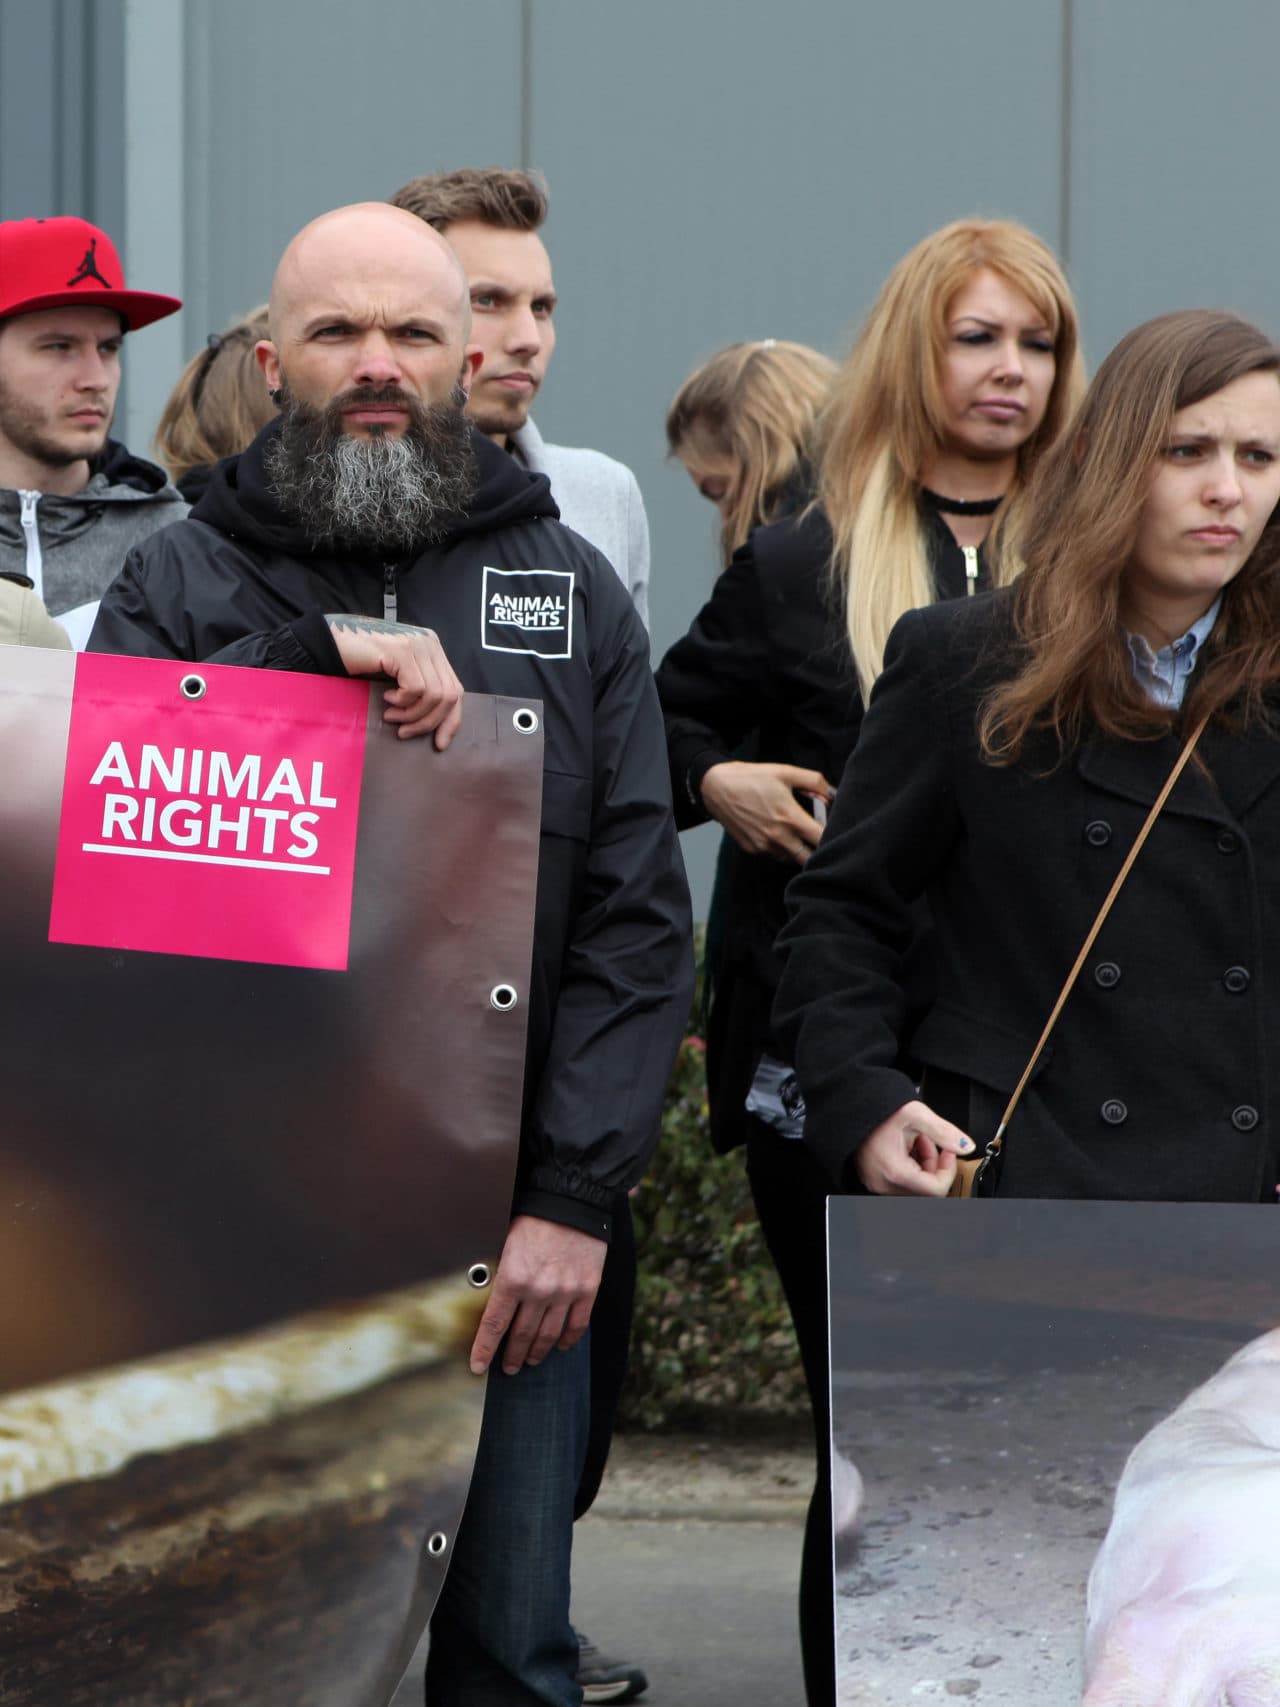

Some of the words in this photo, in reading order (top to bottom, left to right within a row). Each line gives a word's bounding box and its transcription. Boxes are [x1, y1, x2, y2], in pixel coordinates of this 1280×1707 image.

[489, 593, 566, 612] ANIMAL
[494, 606, 561, 626] RIGHTS
[89, 741, 337, 808] ANIMAL
[101, 793, 321, 858] RIGHTS
